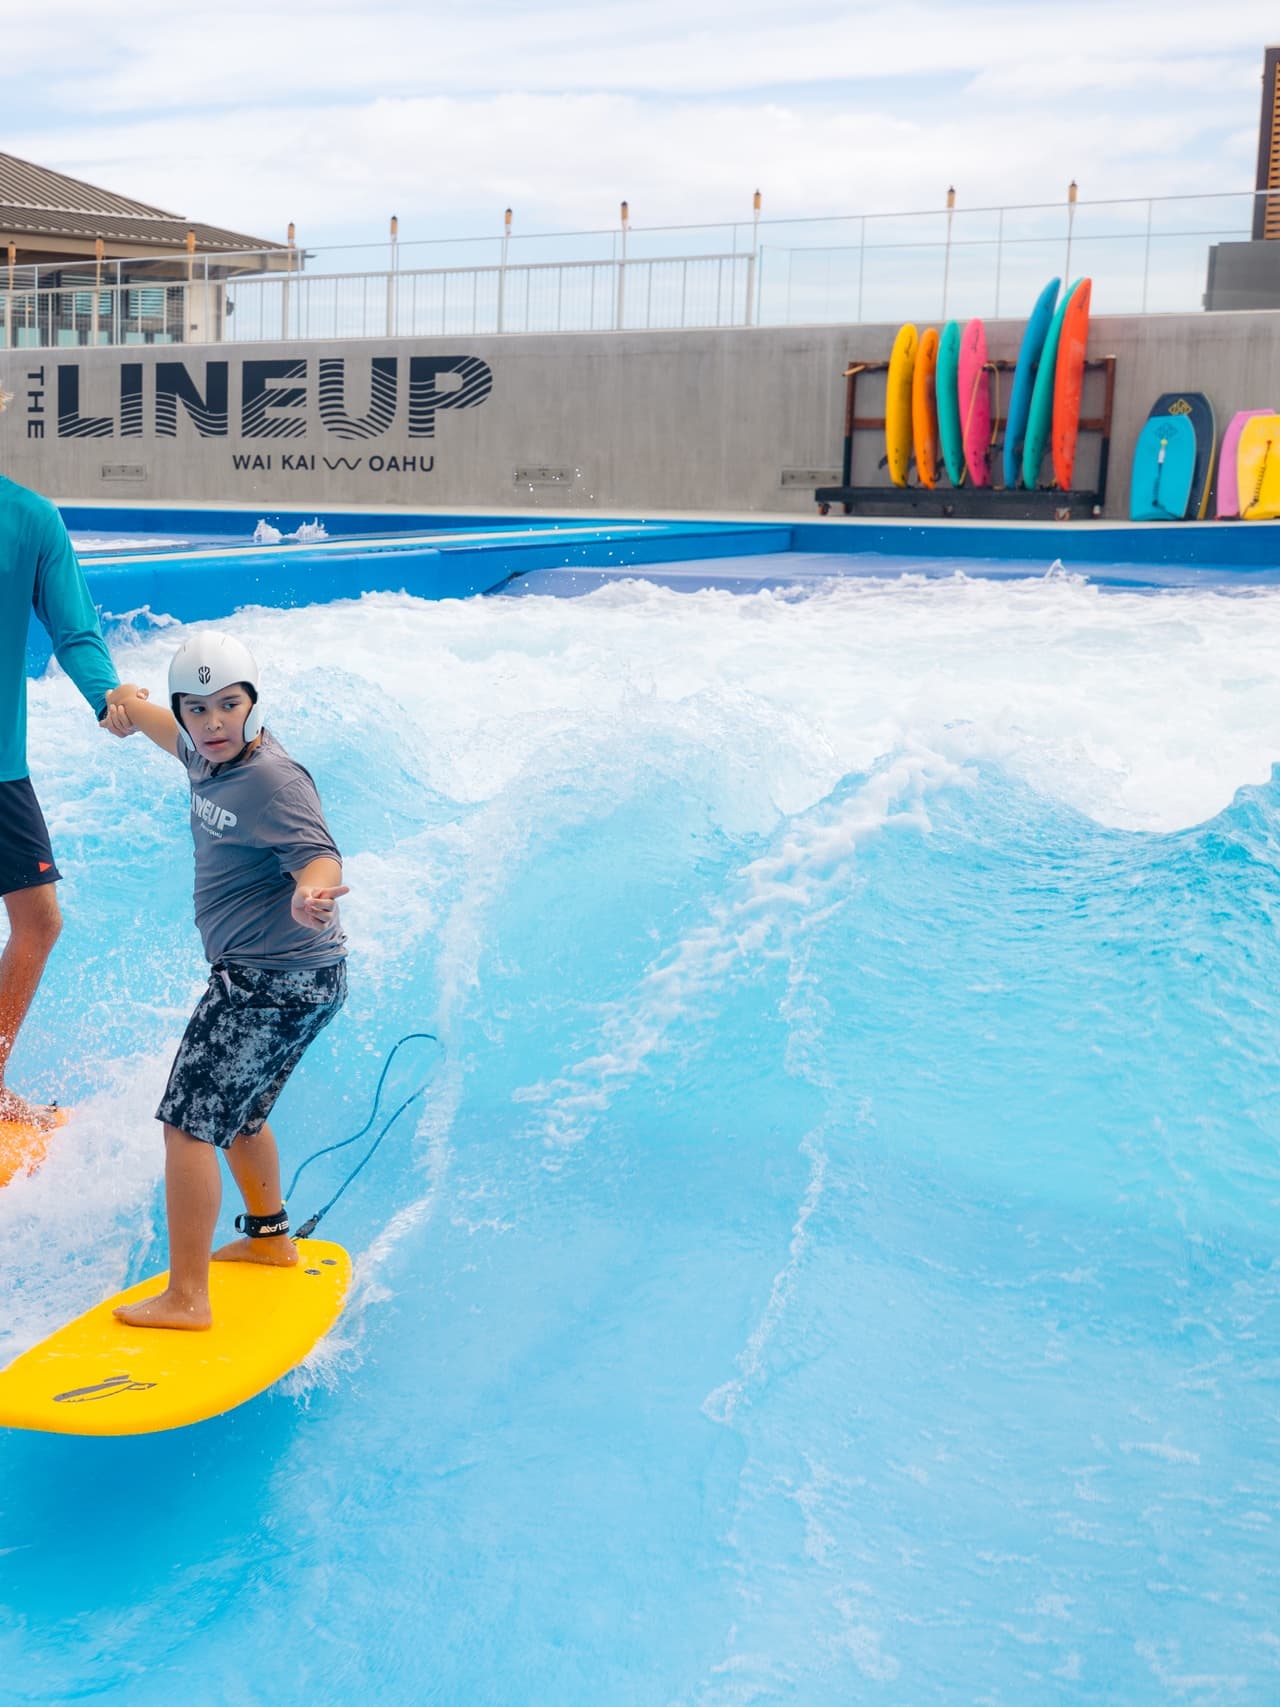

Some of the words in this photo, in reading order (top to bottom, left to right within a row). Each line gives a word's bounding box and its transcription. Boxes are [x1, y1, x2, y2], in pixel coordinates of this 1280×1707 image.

[27, 365, 44, 439] THE
[58, 356, 493, 440] LINEUP
[232, 454, 271, 470] WAI
[282, 454, 315, 470] KAI
[369, 455, 434, 472] OAHU
[191, 792, 237, 830] INEUP
